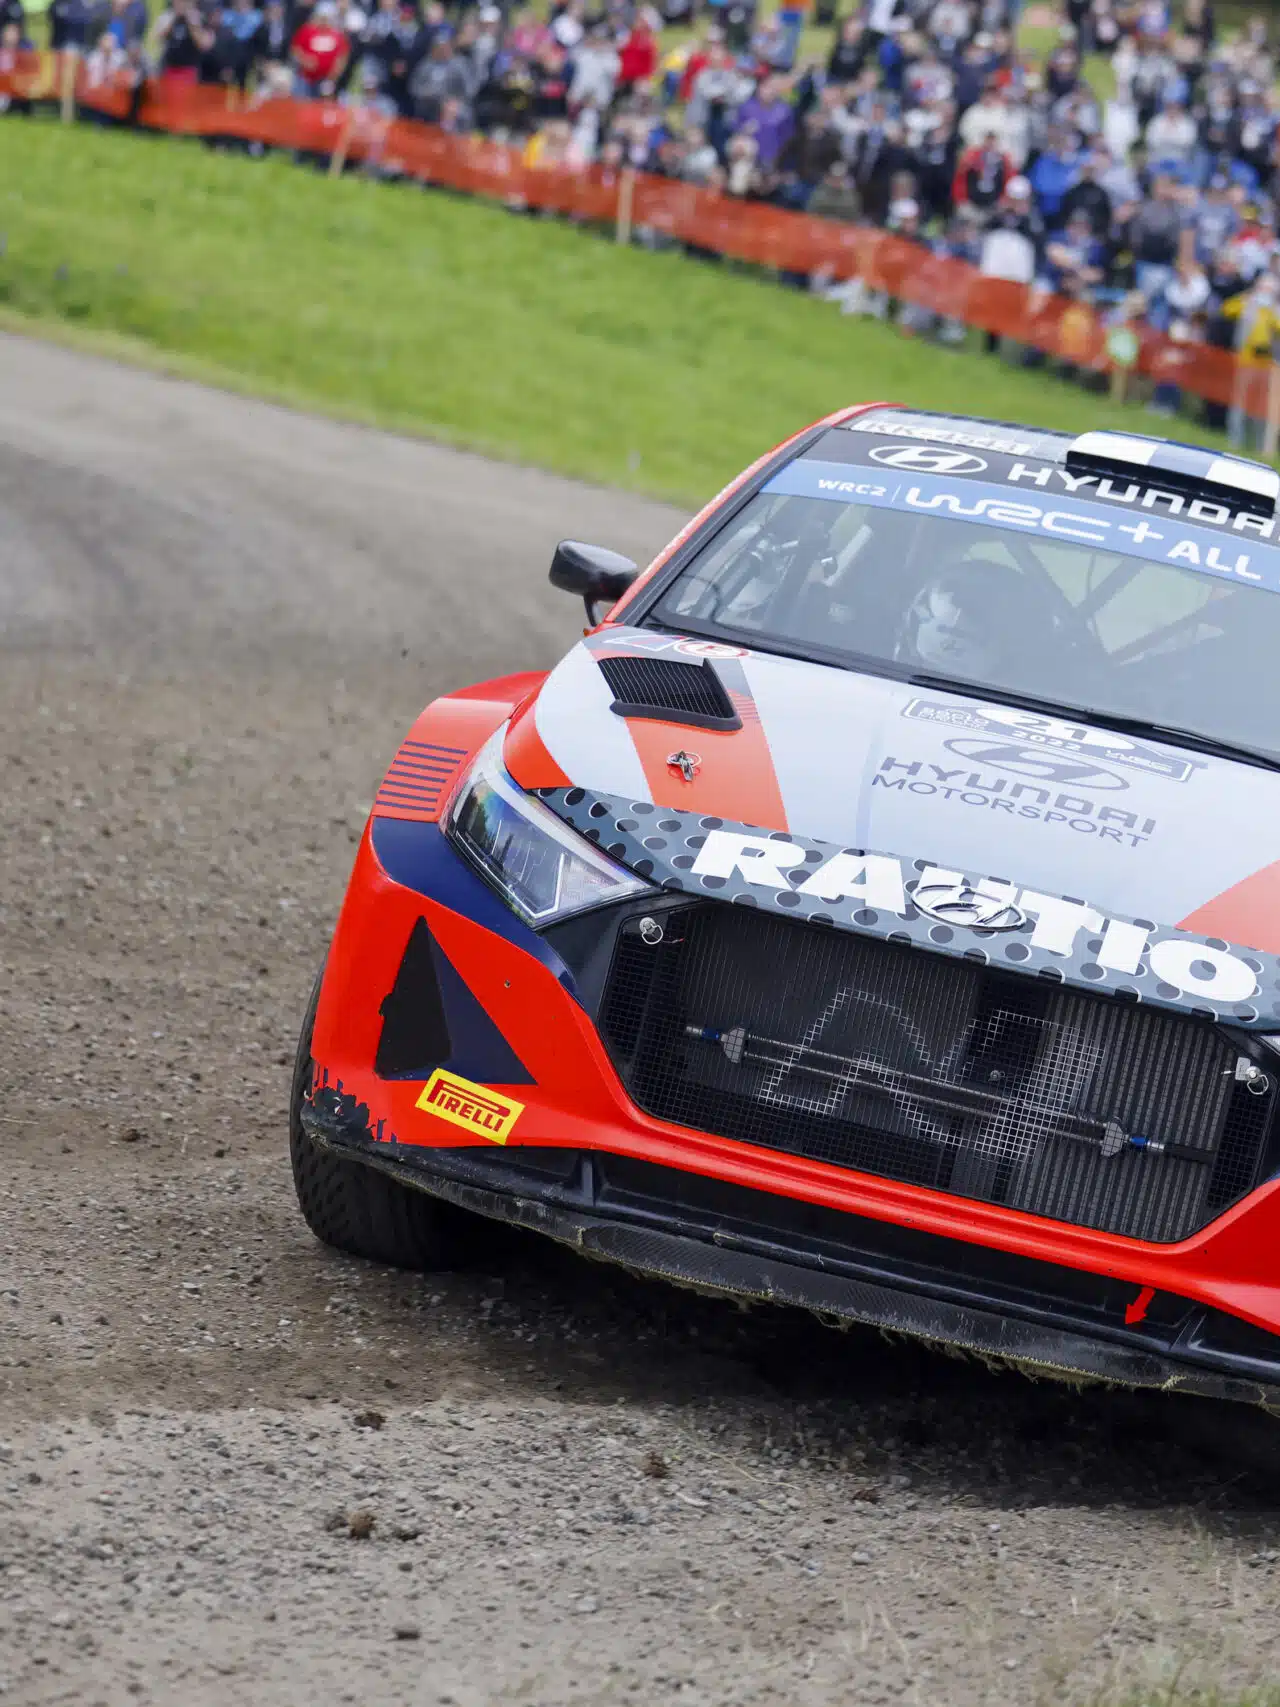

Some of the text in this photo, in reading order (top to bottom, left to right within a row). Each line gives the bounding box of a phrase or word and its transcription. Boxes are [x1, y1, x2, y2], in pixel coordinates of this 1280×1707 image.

[818, 479, 887, 497] WRC2
[1168, 539, 1263, 581] ALL
[1011, 730, 1082, 751] 2022
[1013, 715, 1088, 741] 21
[872, 774, 1149, 848] MOTORSPORT
[880, 756, 1157, 835] HYUNDAI
[427, 1078, 511, 1133] PIRELLI
